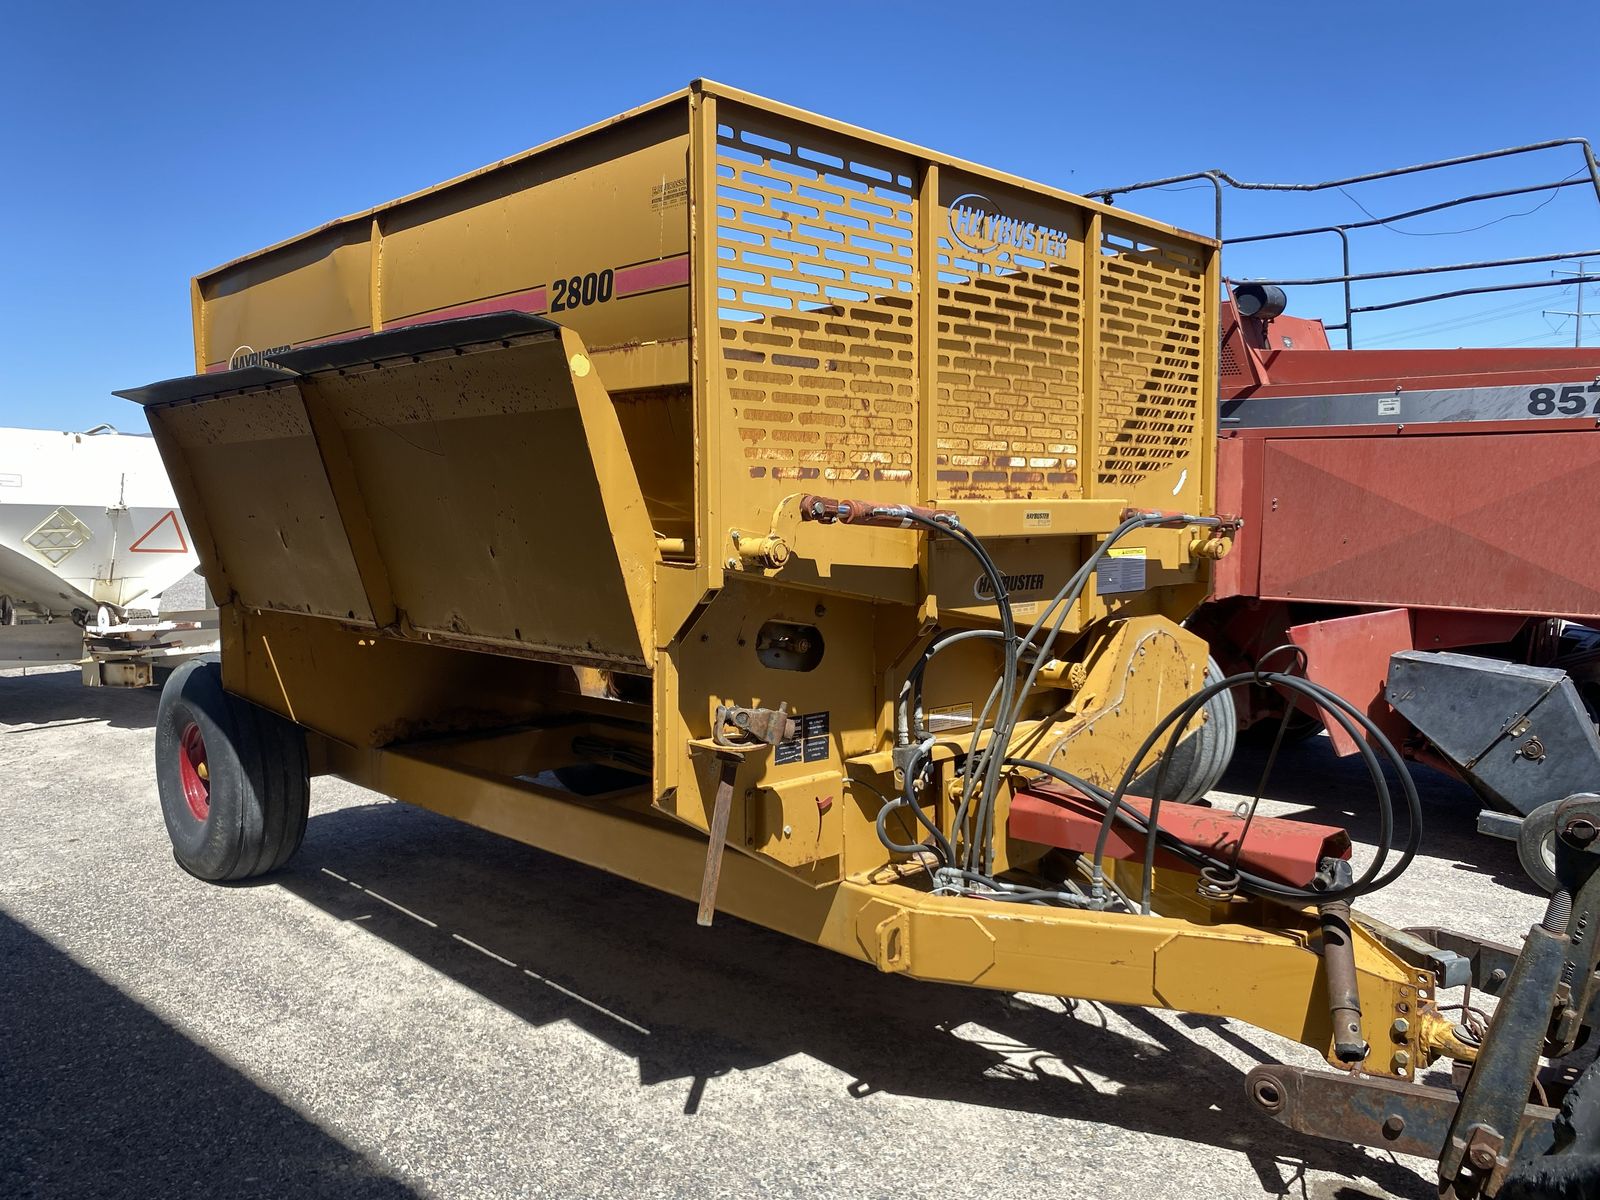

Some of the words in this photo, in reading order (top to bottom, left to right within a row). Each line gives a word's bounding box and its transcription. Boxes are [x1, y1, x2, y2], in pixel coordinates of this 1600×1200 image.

[955, 204, 1068, 259] HAYBUSTER
[551, 268, 614, 313] 2800
[978, 573, 1045, 595] HABUSTER
